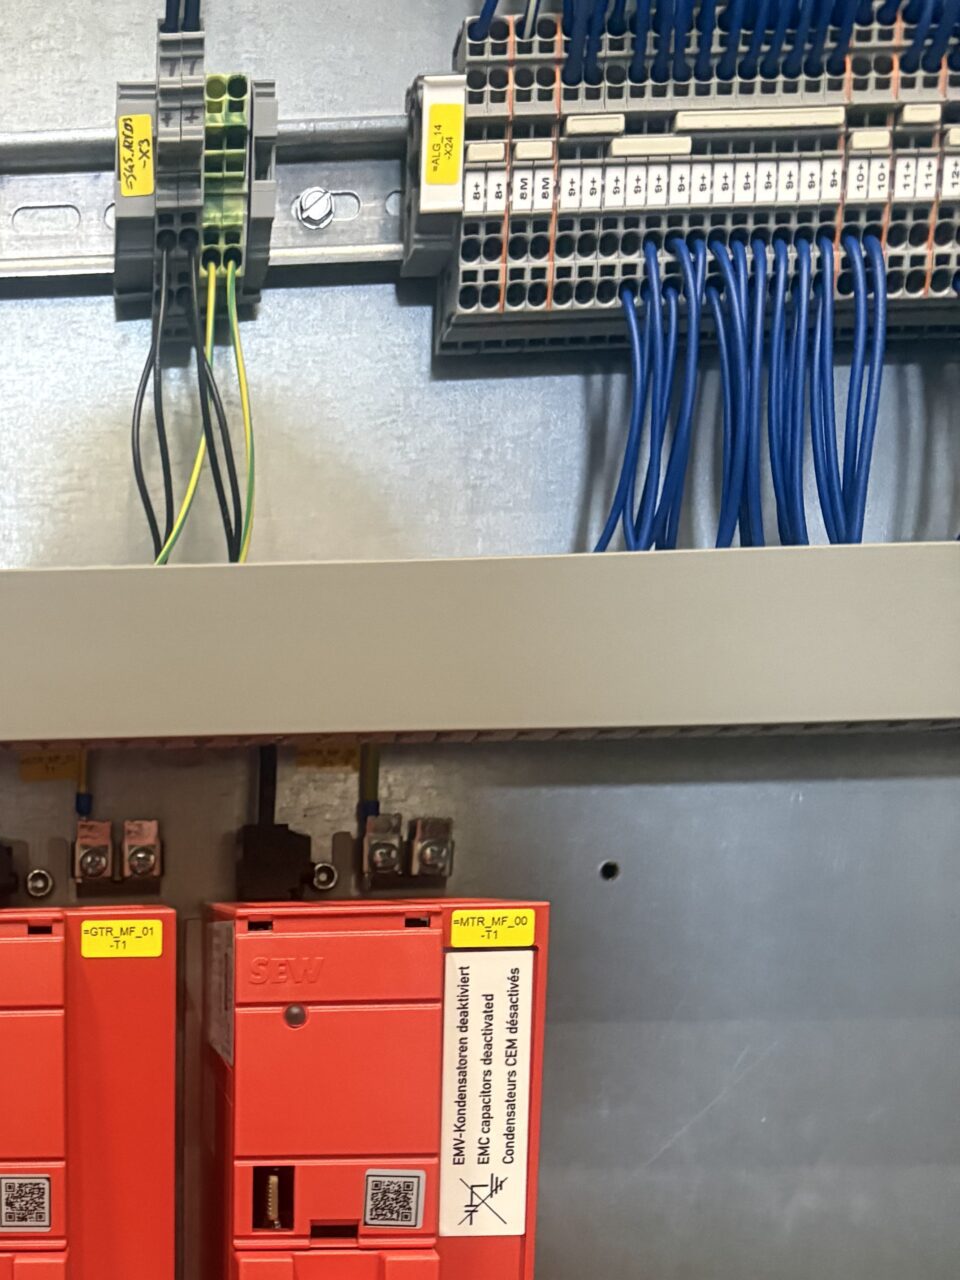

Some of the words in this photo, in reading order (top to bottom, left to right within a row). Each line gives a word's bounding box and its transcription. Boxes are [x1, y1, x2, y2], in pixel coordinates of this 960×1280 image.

[432, 124, 445, 172] =ALG_14
[444, 136, 453, 161] -X24
[83, 926, 154, 940] =GTR_MF_01
[453, 916, 527, 929] =MTR_MF_00
[481, 930, 499, 940] -T1
[110, 940, 127, 950] -T1
[249, 956, 324, 985] SEW
[456, 965, 470, 1032] deaktiviert
[506, 967, 520, 1035] désactivés
[480, 994, 495, 1066] deactivated
[505, 1038, 518, 1068] CEM
[453, 1036, 469, 1166] EMV-Kondensatoren
[479, 1069, 494, 1135] capacitors
[502, 1070, 517, 1165] Condensateurs
[477, 1136, 491, 1165] EMC
